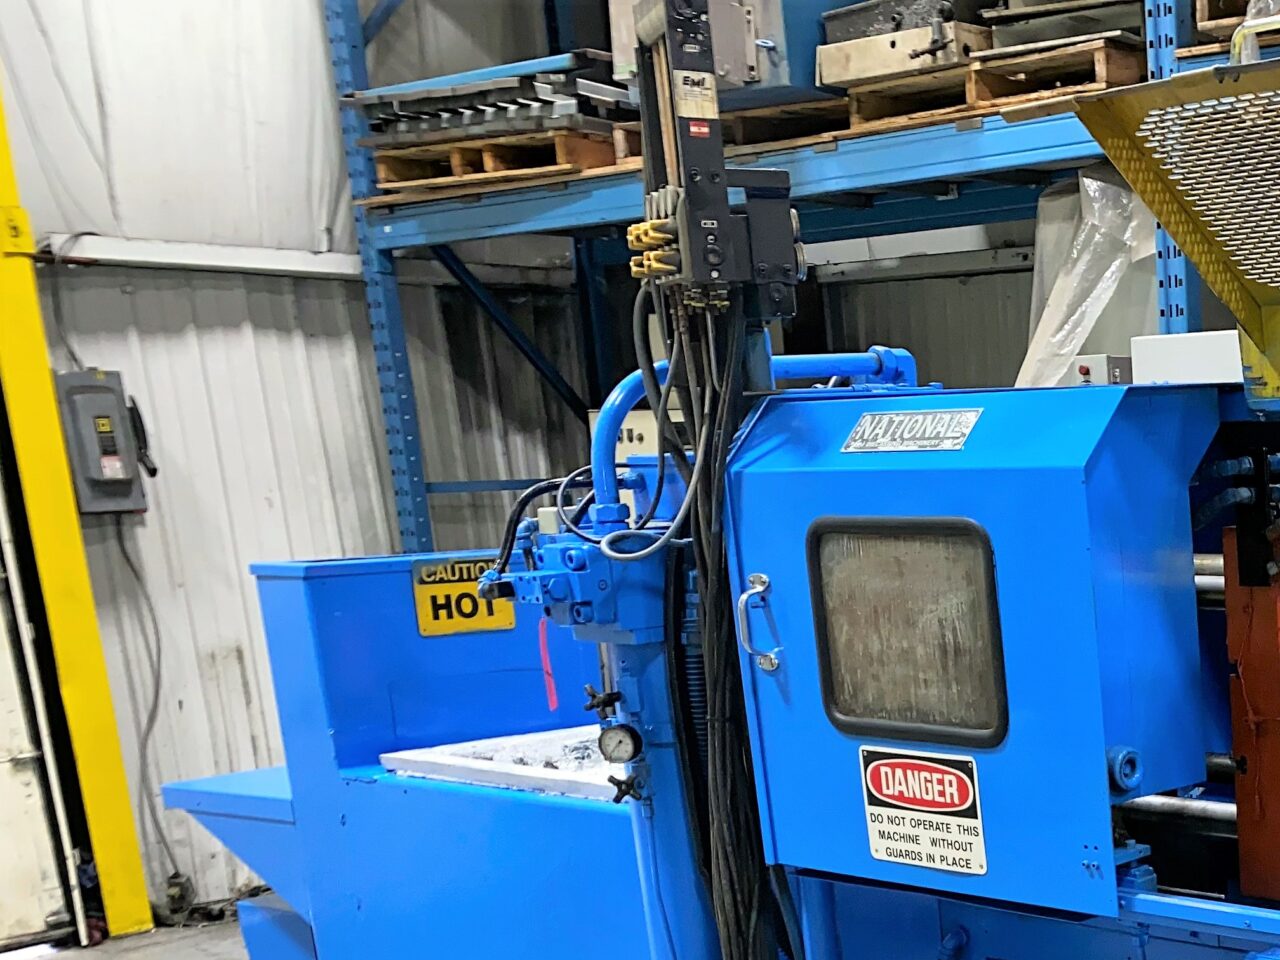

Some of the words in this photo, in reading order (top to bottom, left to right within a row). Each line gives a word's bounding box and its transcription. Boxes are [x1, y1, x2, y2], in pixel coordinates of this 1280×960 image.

[855, 413, 963, 440] NATIONAL
[879, 765, 959, 804] DANGER
[870, 813, 884, 824] DO
[887, 815, 906, 826] NOT
[910, 818, 952, 834] OPERATE
[957, 824, 980, 837] THIS
[878, 830, 921, 845] MACHINE
[929, 837, 973, 852] WITHOUT
[886, 847, 922, 861] GUARDS
[926, 853, 935, 863] IN
[940, 855, 972, 869] PLACE
